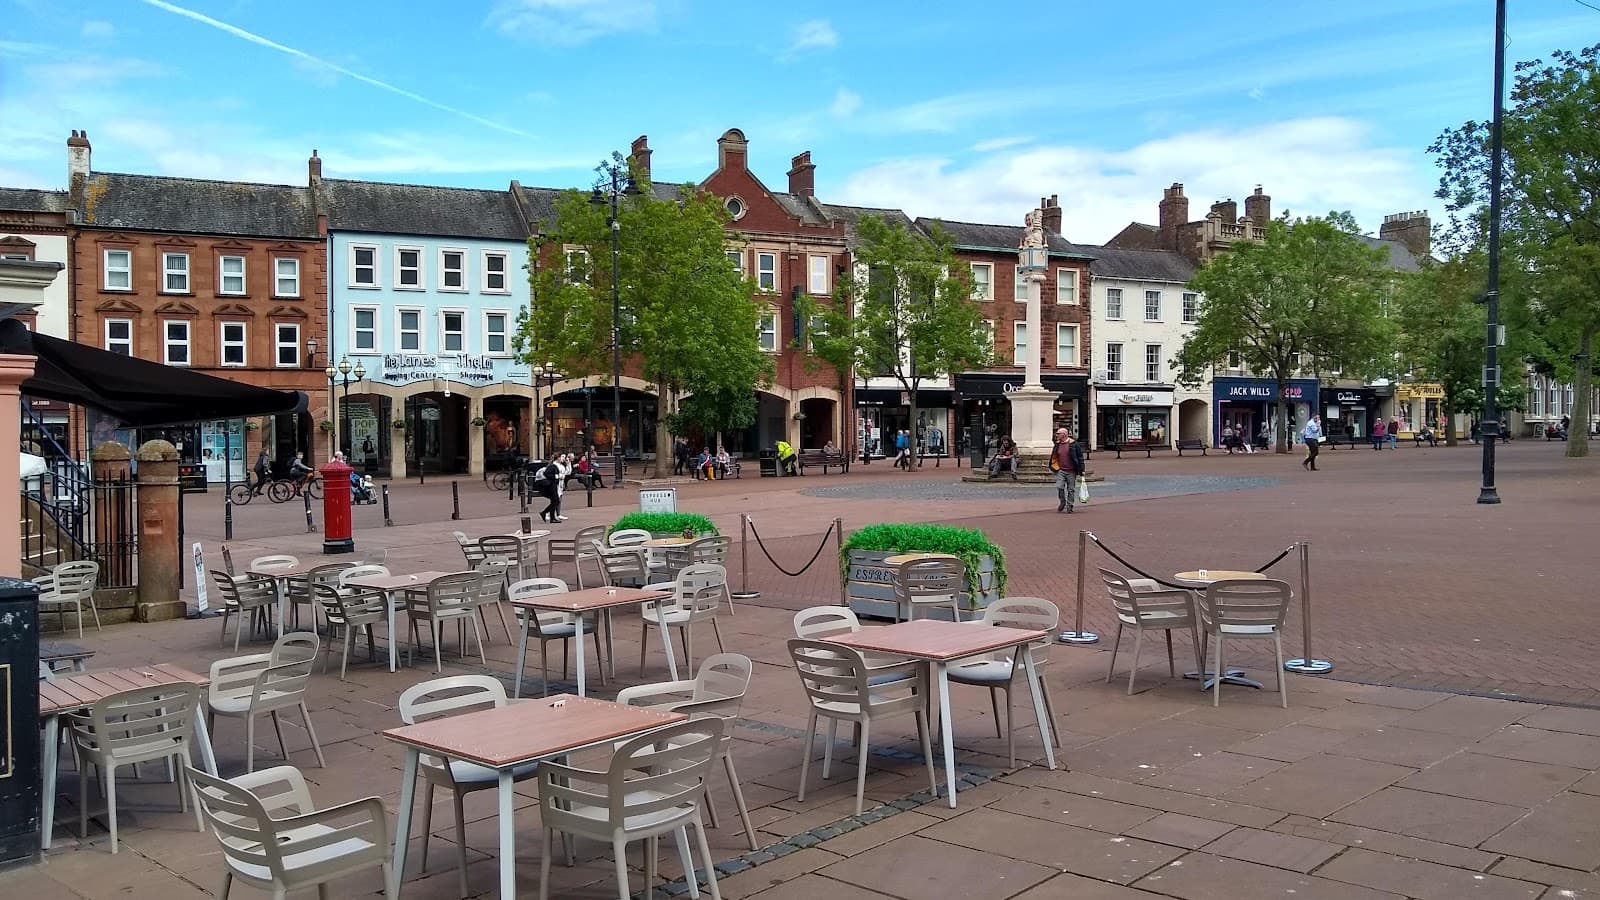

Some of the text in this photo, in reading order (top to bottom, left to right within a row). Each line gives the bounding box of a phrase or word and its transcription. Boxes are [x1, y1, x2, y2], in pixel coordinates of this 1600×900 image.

[1229, 387, 1270, 396] JACK WILLS
[354, 420, 376, 429] POP
[354, 429, 369, 438] UP
